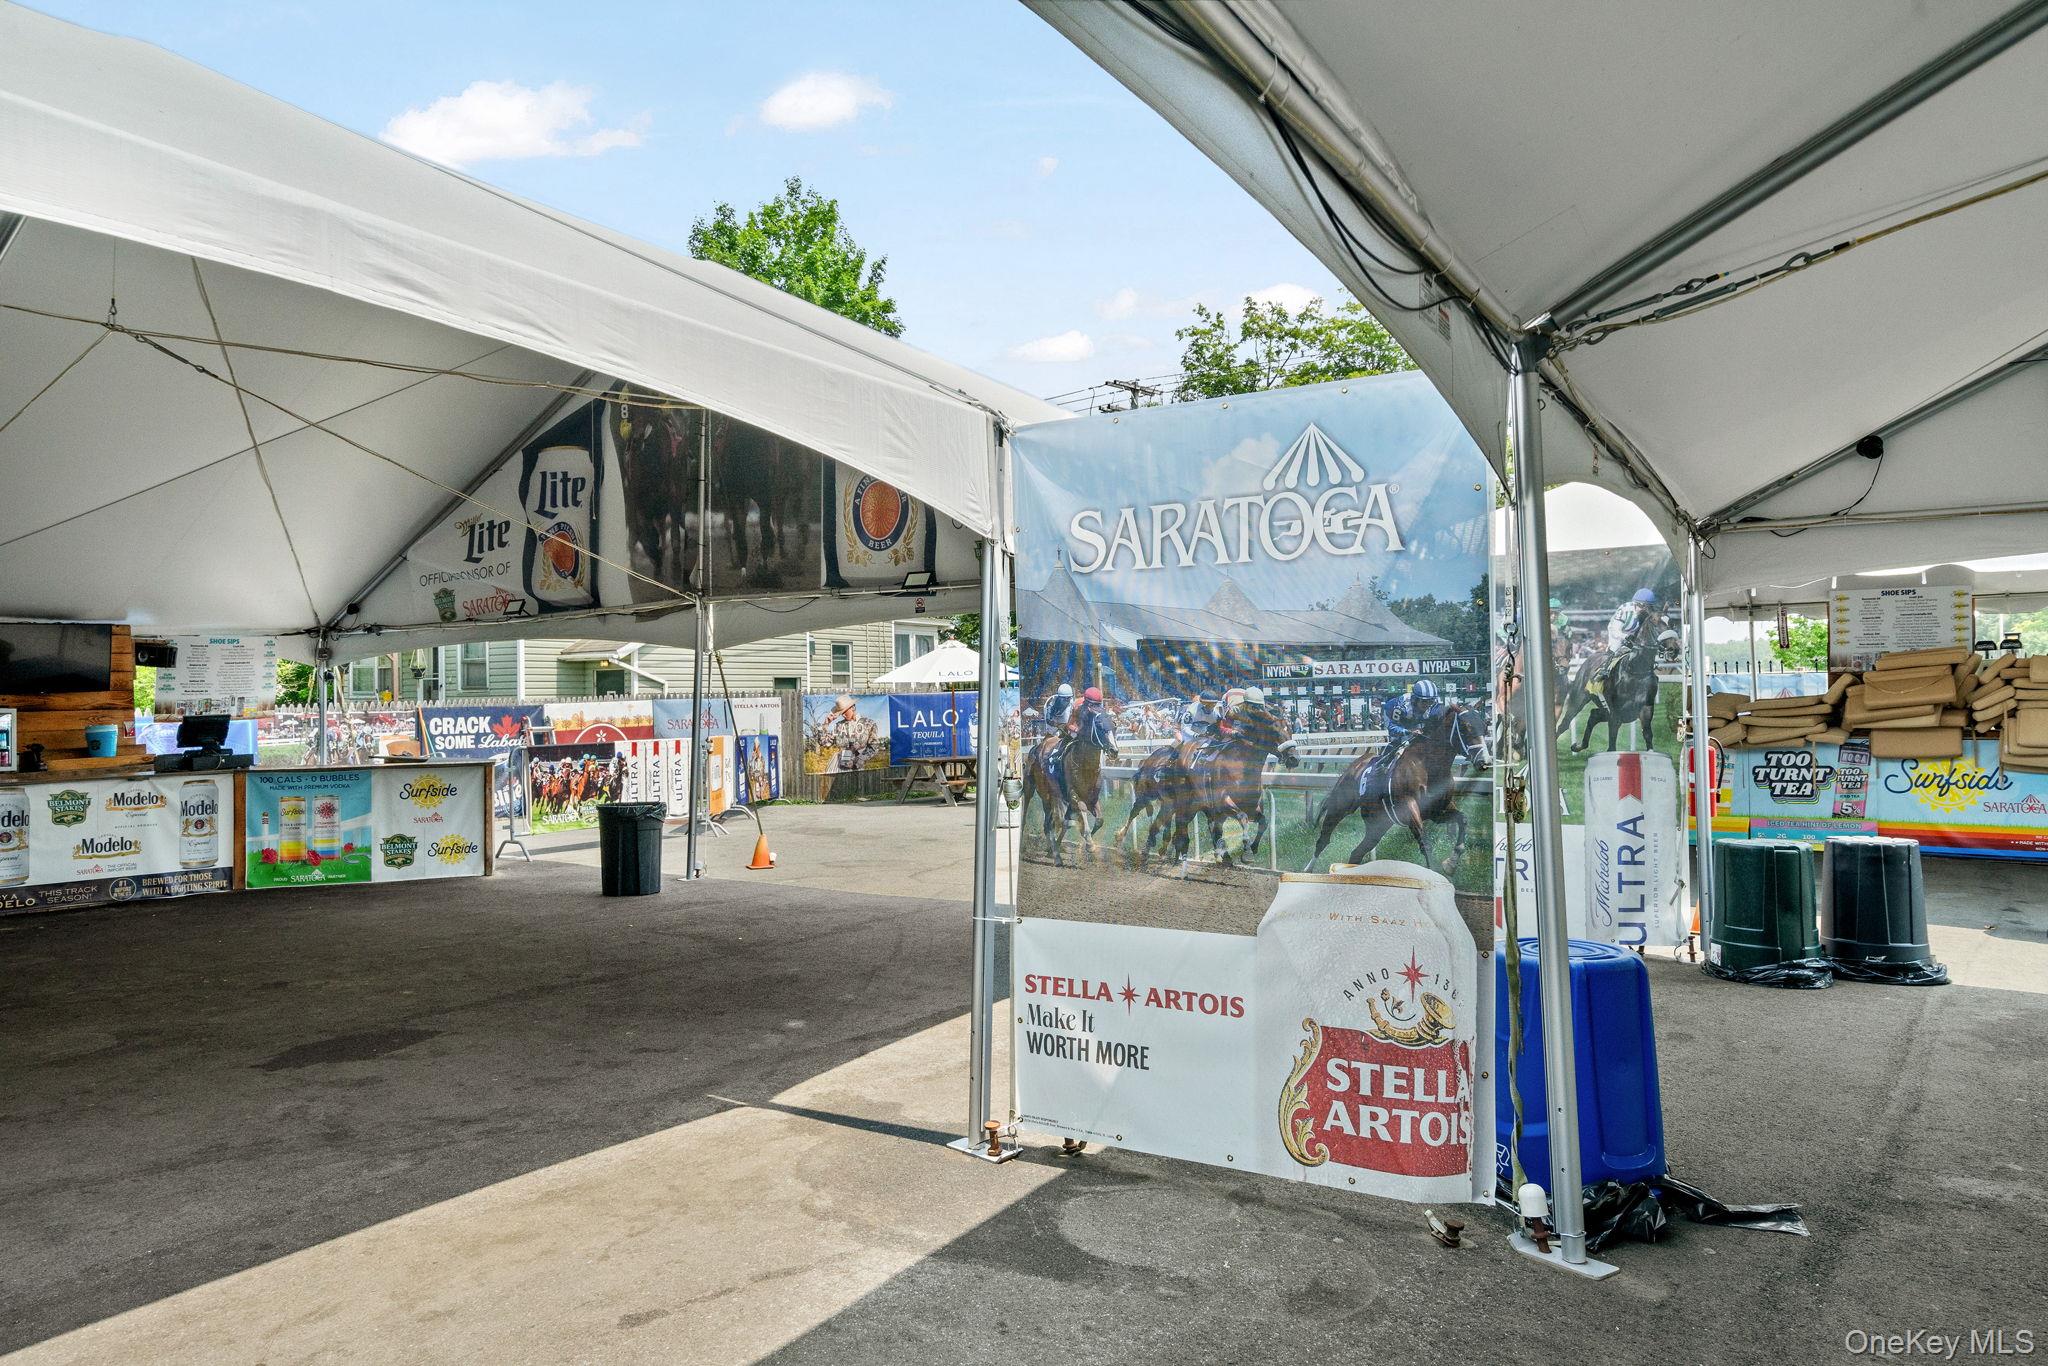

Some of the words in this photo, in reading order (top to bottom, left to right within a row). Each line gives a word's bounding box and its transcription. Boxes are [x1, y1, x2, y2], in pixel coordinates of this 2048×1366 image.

[620, 403, 629, 419] 8
[534, 470, 587, 520] Lite
[1068, 483, 1406, 574] SARATOGA
[463, 519, 511, 563] Lite
[867, 539, 893, 549] BEER
[496, 562, 511, 578] OF
[1266, 665, 1292, 678] NYRA
[1314, 661, 1418, 676] SARATOGA
[1422, 660, 1450, 674] NYRA
[1450, 659, 1471, 667] BETS
[429, 716, 492, 735] CRACK
[667, 718, 720, 730] SARAOGA
[897, 709, 959, 728] LALO
[832, 721, 865, 736] LALO
[912, 731, 945, 739] TEQUILA
[435, 735, 476, 750] SOME
[478, 733, 525, 749] Labat
[1766, 753, 1812, 767] TOO
[259, 776, 273, 784] 100
[276, 776, 303, 784] CALS
[319, 773, 360, 782] BUBBLES
[675, 759, 683, 802] ULTRA
[1754, 767, 1831, 781] TURNT
[1884, 758, 2014, 797] Surfside
[399, 783, 458, 800] Surfside
[1771, 782, 1812, 796] TEA
[1841, 781, 1862, 789] TEA
[48, 799, 90, 807] BELMONT
[112, 791, 159, 807] Modelo
[54, 805, 85, 813] STAKES
[180, 800, 219, 817] Modelo
[1840, 802, 1861, 814] 5%
[1983, 800, 2048, 815] SARATOGA
[0, 809, 30, 828] delo
[81, 836, 132, 855] Modelo
[386, 848, 412, 856] STAKES
[427, 842, 478, 857] Surfside
[142, 876, 174, 887] BREWED
[173, 874, 188, 883] FOR
[188, 872, 213, 881] THOSE
[290, 874, 326, 883] SARATOGA
[1593, 838, 1613, 927] Michelob
[1616, 813, 1649, 946] ULTRA
[38, 890, 62, 899] THIS
[65, 885, 98, 895] TRACK
[142, 886, 164, 896] WITH
[171, 882, 203, 894] FIGHTING
[202, 879, 228, 889] SPIRIT
[47, 894, 92, 904] SEASON!
[1342, 967, 1390, 1001] ANNO
[1024, 973, 1114, 1003] STELLA
[1144, 987, 1245, 1019] ARTOIS
[1026, 1003, 1077, 1031] Make
[1081, 1009, 1096, 1033] It
[1026, 1030, 1090, 1063] WORTH
[1095, 1040, 1150, 1071] MORE
[1326, 1057, 1470, 1104] STELLA
[1322, 1100, 1471, 1147] ARTOIS
